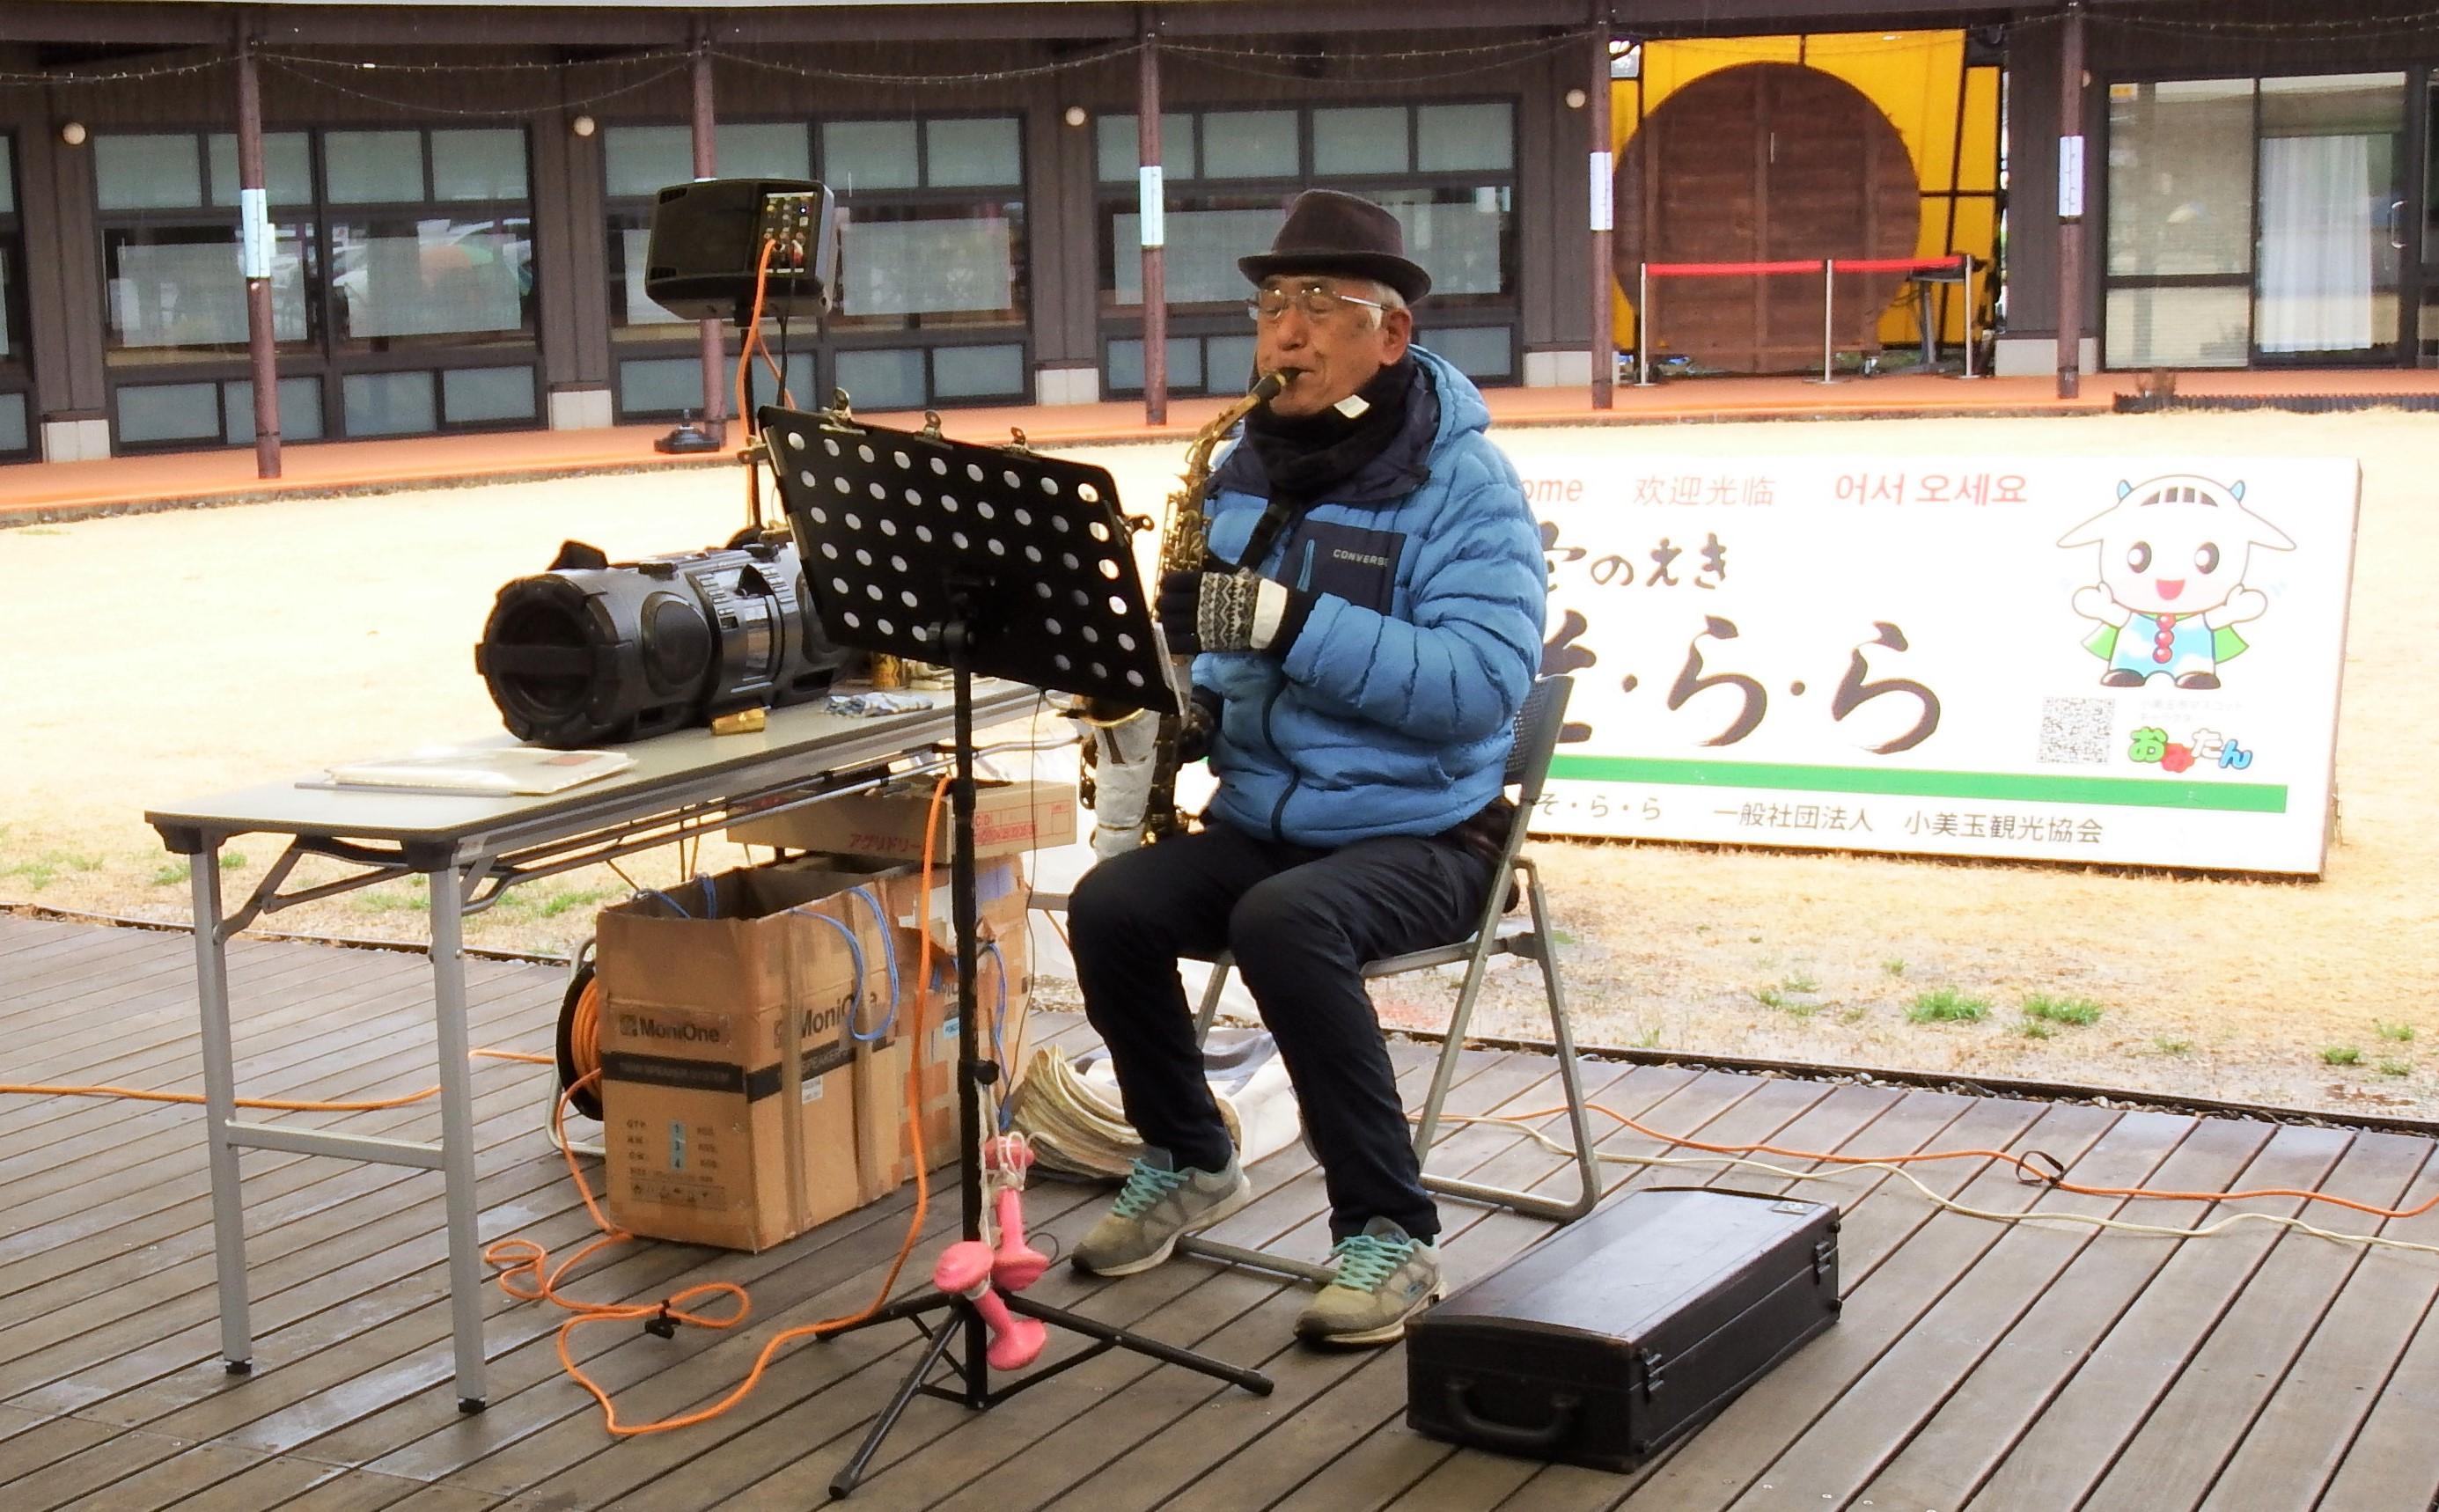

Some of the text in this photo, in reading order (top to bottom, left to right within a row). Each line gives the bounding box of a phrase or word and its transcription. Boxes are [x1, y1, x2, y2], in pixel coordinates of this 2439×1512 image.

[1634, 475, 1775, 506] 欢迎光临
[1836, 473, 2027, 506] 어서 오세요
[1713, 802, 1874, 833] 一般社団法人
[1904, 811, 2104, 845] 小美玉観光協会
[639, 1017, 720, 1043] MoniOne
